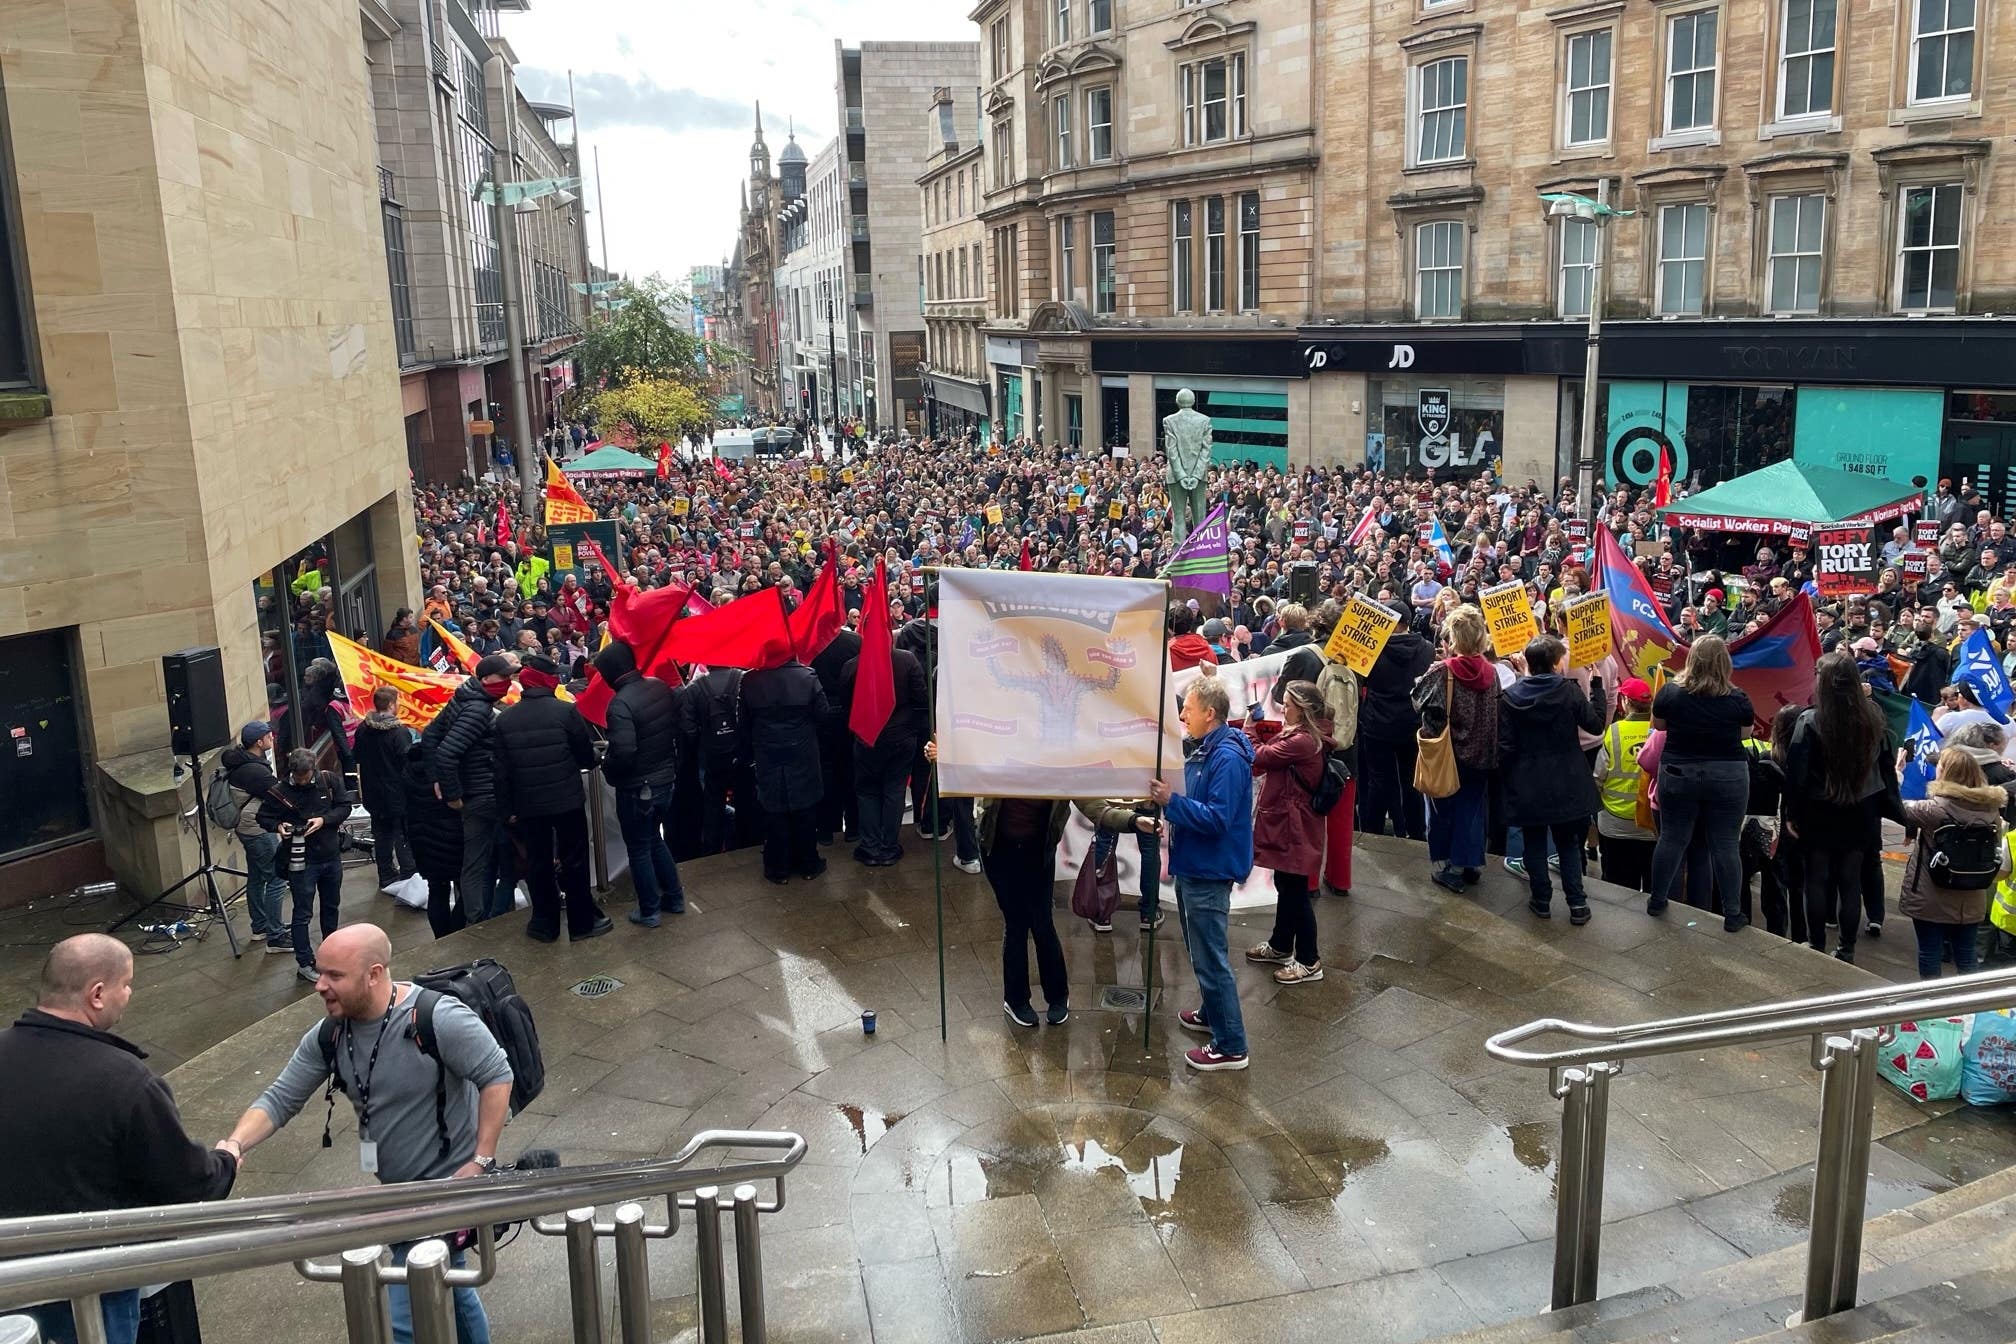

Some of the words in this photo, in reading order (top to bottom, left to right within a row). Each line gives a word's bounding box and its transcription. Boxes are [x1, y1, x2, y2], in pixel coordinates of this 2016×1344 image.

[1309, 351, 1327, 368] JD
[1388, 344, 1415, 368] JD
[1422, 404, 1446, 414] KING
[1866, 454, 1888, 464] FLOOR
[1865, 464, 1875, 476] SQ
[1878, 466, 1887, 474] FT
[1872, 508, 1898, 522] Workers
[1679, 516, 1722, 528] Socialist
[1724, 518, 1769, 532] Workers
[1792, 527, 1808, 536] TORY
[1818, 529, 1870, 545] DEFY
[1819, 543, 1872, 559] TORY
[1821, 557, 1872, 573] RULE
[1485, 590, 1522, 610] SUPPORT
[1351, 602, 1392, 630] SUPPORT
[1500, 604, 1517, 616] THE
[1570, 599, 1606, 621] SUPPORT
[1357, 618, 1376, 636] THE
[1494, 612, 1528, 630] STRIKES
[1581, 614, 1596, 628] THE
[1341, 624, 1378, 650] STRIKES
[1574, 623, 1605, 644] STRIKES
